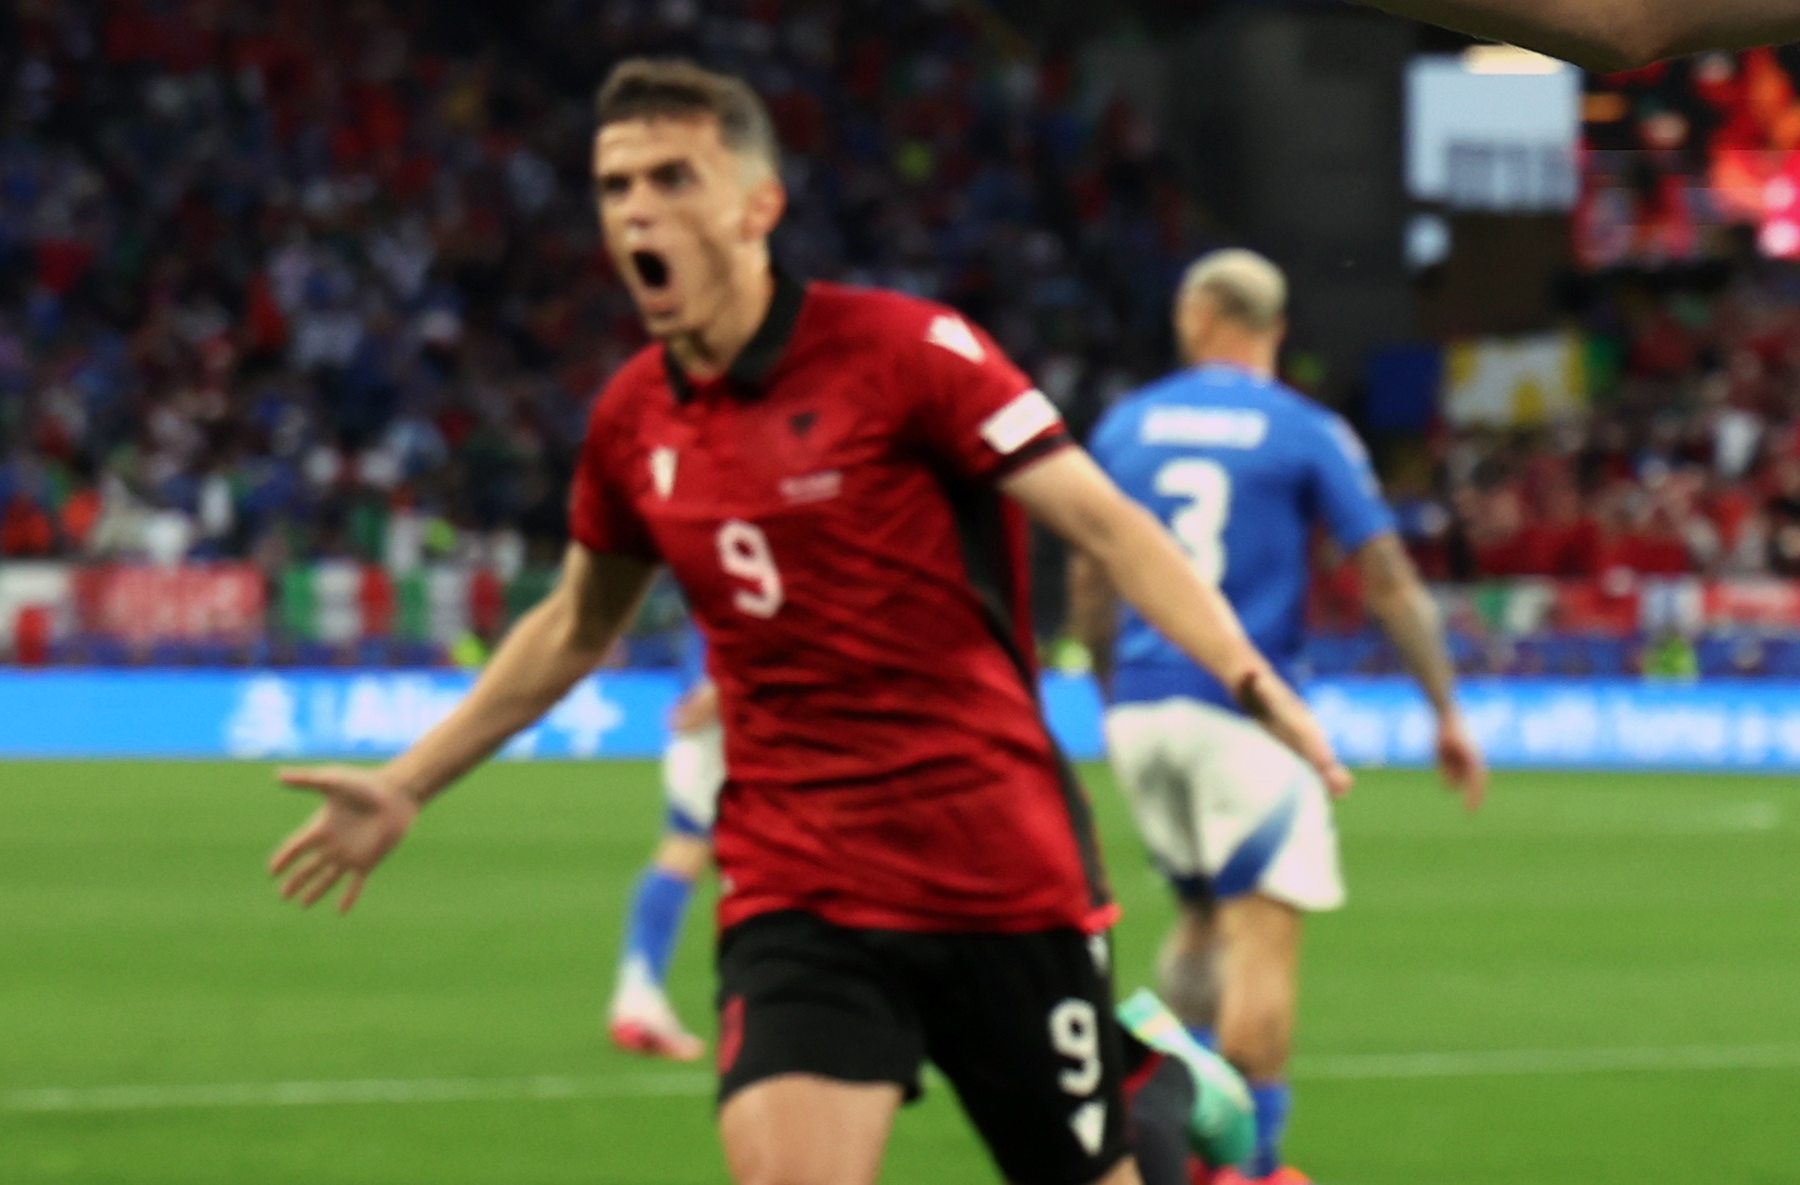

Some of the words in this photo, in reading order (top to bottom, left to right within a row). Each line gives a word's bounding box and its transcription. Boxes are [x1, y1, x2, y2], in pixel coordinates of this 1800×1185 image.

[716, 518, 785, 619] 9
[1155, 455, 1232, 591] 3
[1048, 996, 1103, 1097] 9
